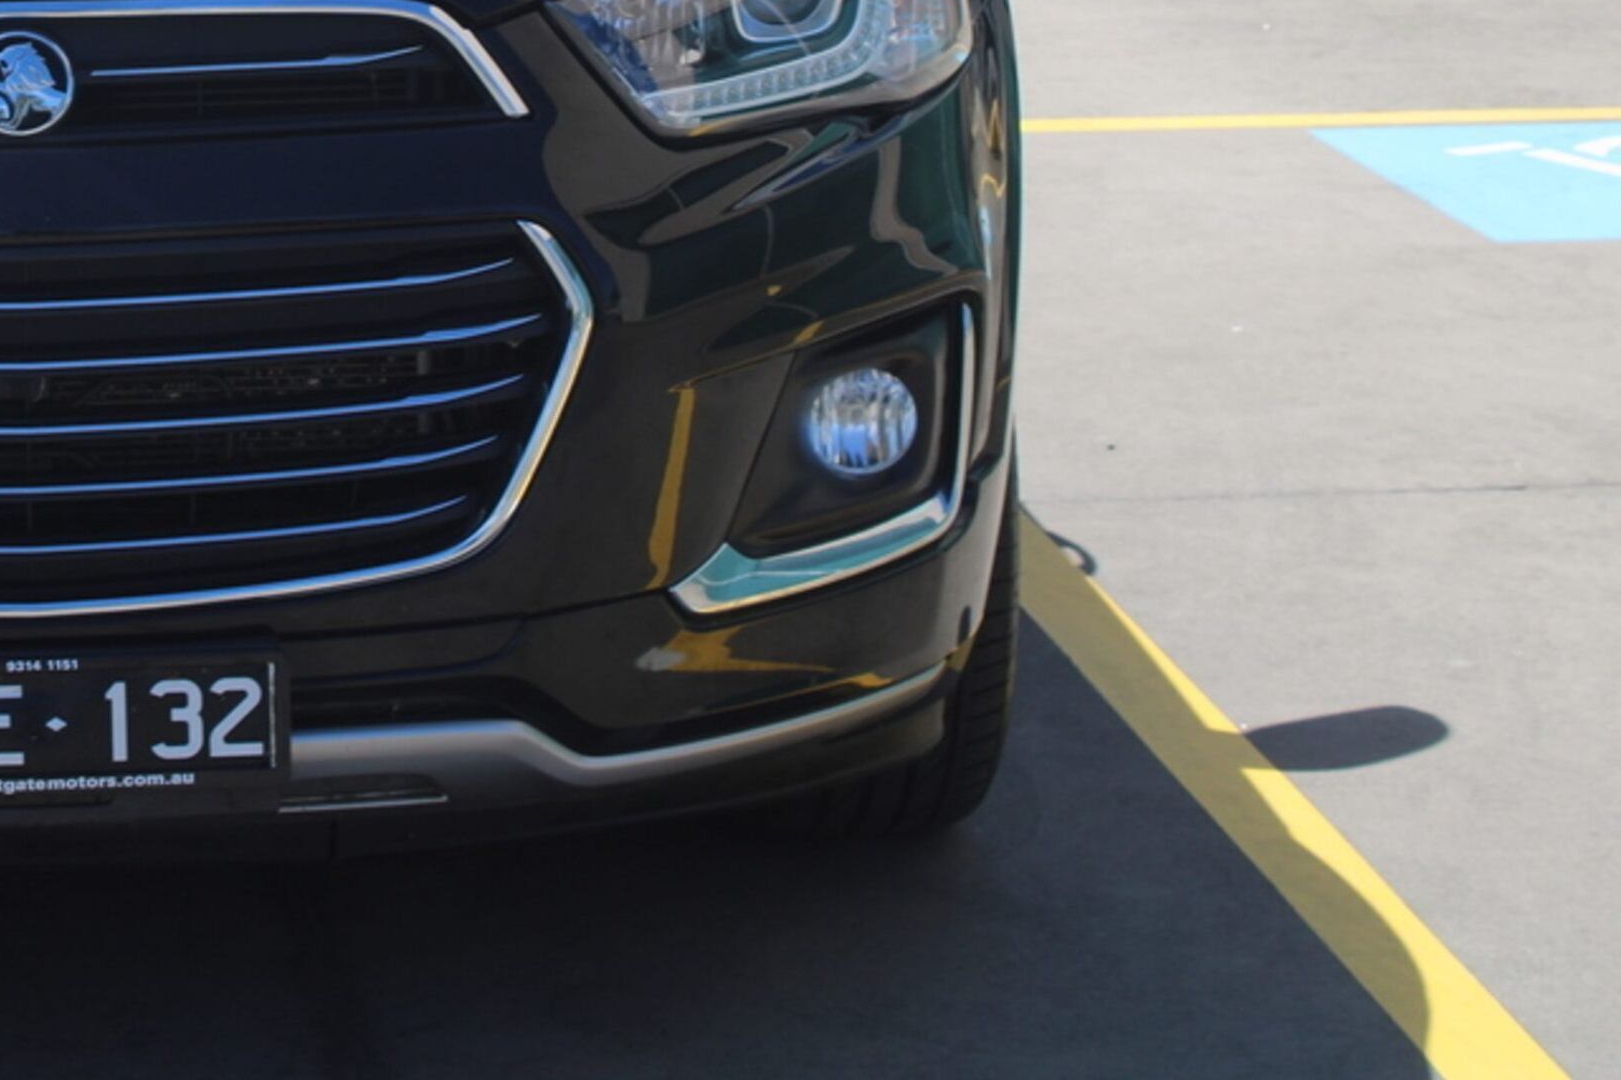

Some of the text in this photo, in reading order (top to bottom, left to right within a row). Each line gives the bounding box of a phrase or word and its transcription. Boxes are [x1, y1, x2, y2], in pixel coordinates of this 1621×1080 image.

[5, 658, 79, 673] 9314 1151
[103, 676, 265, 763] 132
